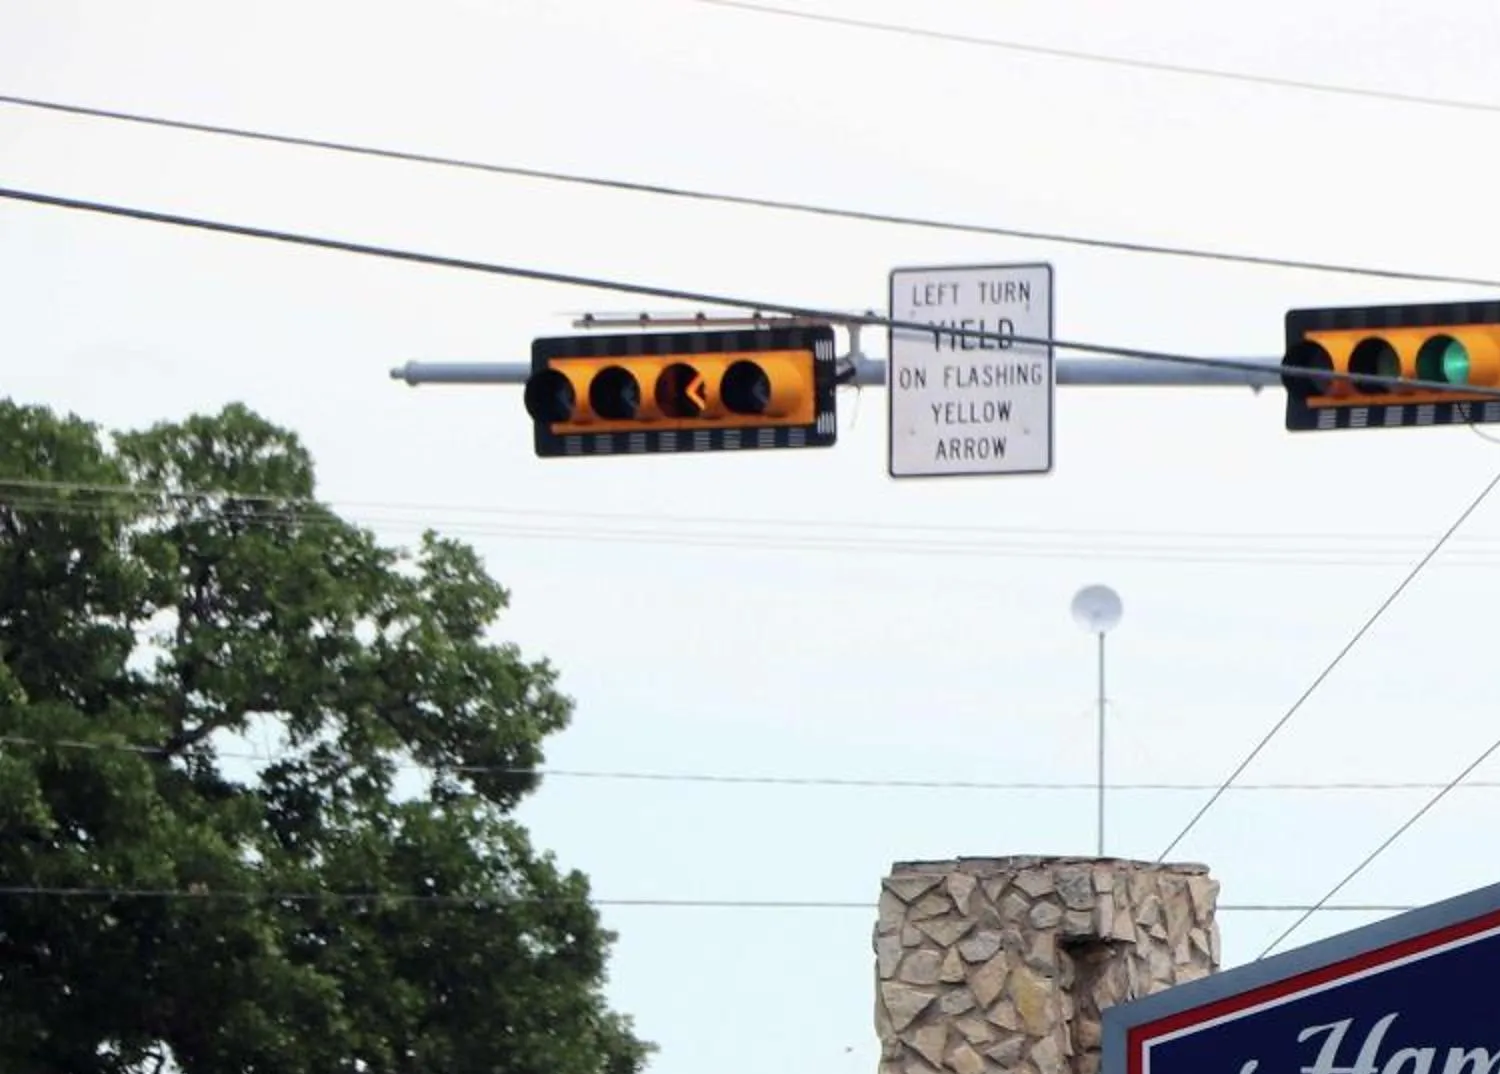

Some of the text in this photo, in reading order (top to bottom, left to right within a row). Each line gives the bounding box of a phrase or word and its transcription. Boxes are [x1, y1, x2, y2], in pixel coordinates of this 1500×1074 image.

[912, 281, 1031, 307] LEFT TURN
[929, 316, 1014, 352] YIELD
[899, 363, 1043, 390] ON FLASHING
[931, 400, 1013, 425] YELLOW
[934, 437, 1007, 461] ARROW
